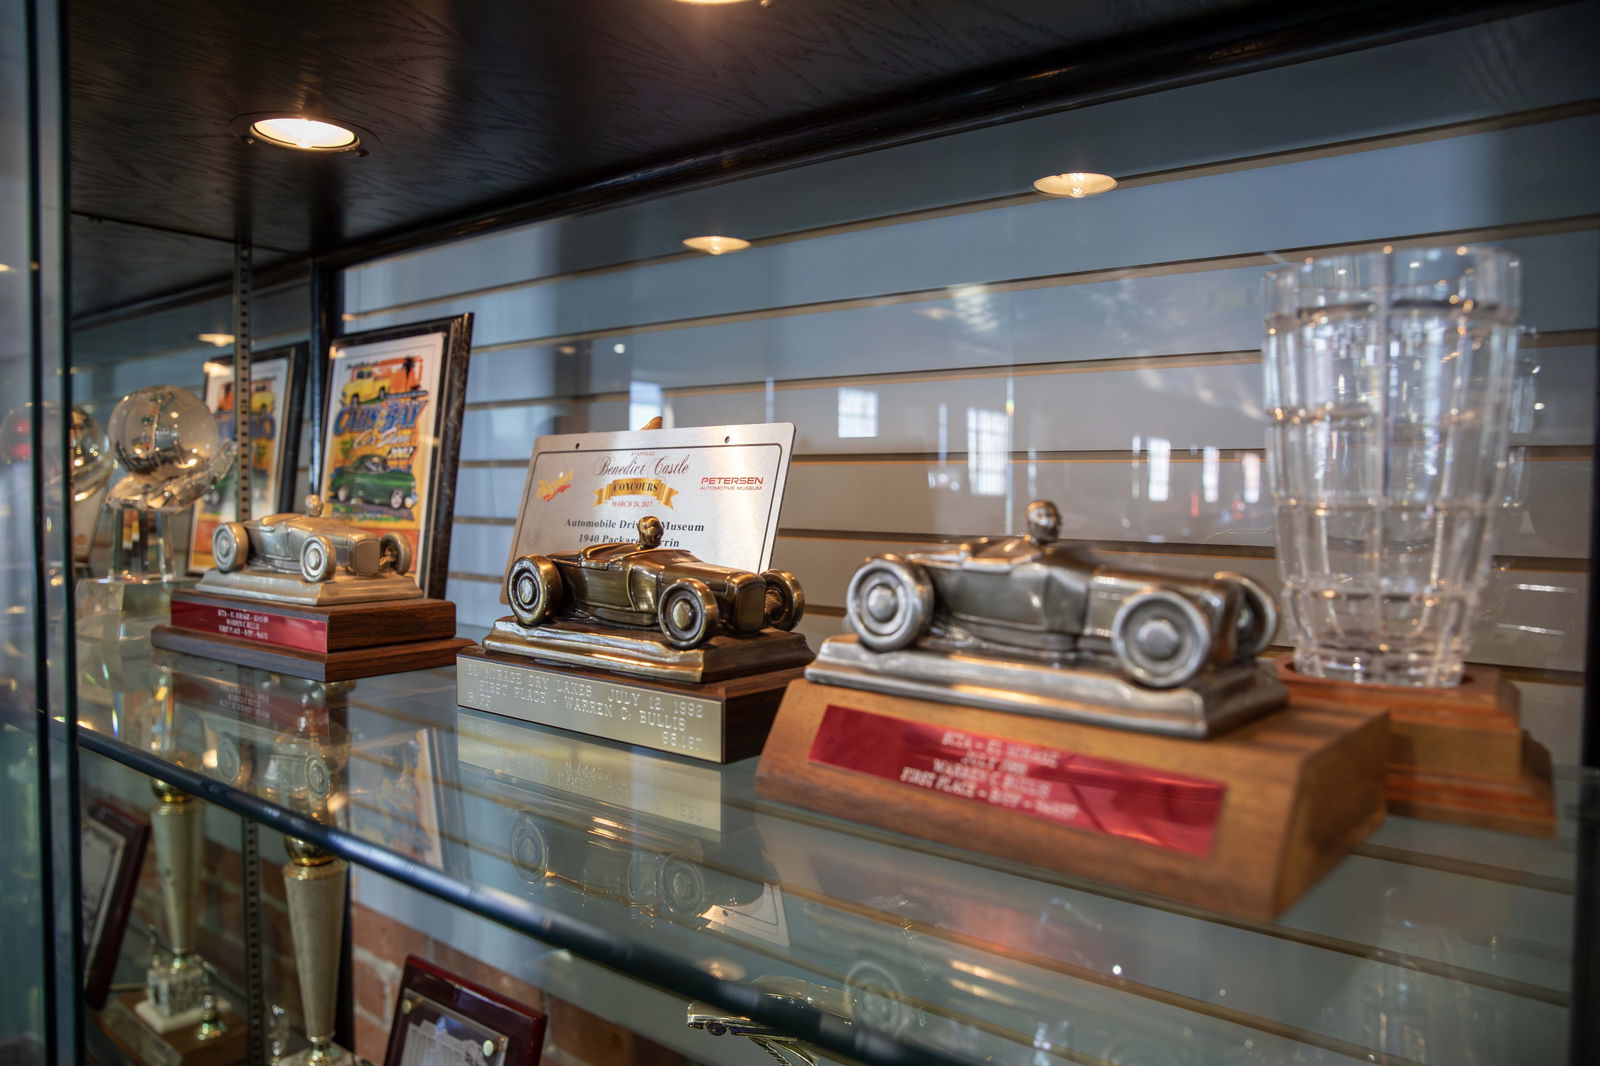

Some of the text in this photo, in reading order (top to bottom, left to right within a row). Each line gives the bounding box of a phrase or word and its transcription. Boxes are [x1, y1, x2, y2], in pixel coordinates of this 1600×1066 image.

[594, 454, 690, 476] Benedict Castle
[613, 481, 658, 492] CONCOURS
[700, 476, 764, 485] PETERSEN
[564, 519, 616, 529] Automobile
[661, 521, 705, 532] Museum
[579, 534, 600, 543] 1940
[484, 666, 521, 685] MIRAGE
[529, 674, 550, 690] DRY
[556, 679, 592, 698] LAKES
[607, 689, 640, 707] JULY
[480, 679, 508, 696] FIRST
[514, 686, 546, 704] PLACE
[563, 695, 613, 717] WARREN
[639, 710, 687, 732] BULLIS
[899, 766, 937, 788] FIRST
[934, 774, 978, 798] PLACE
